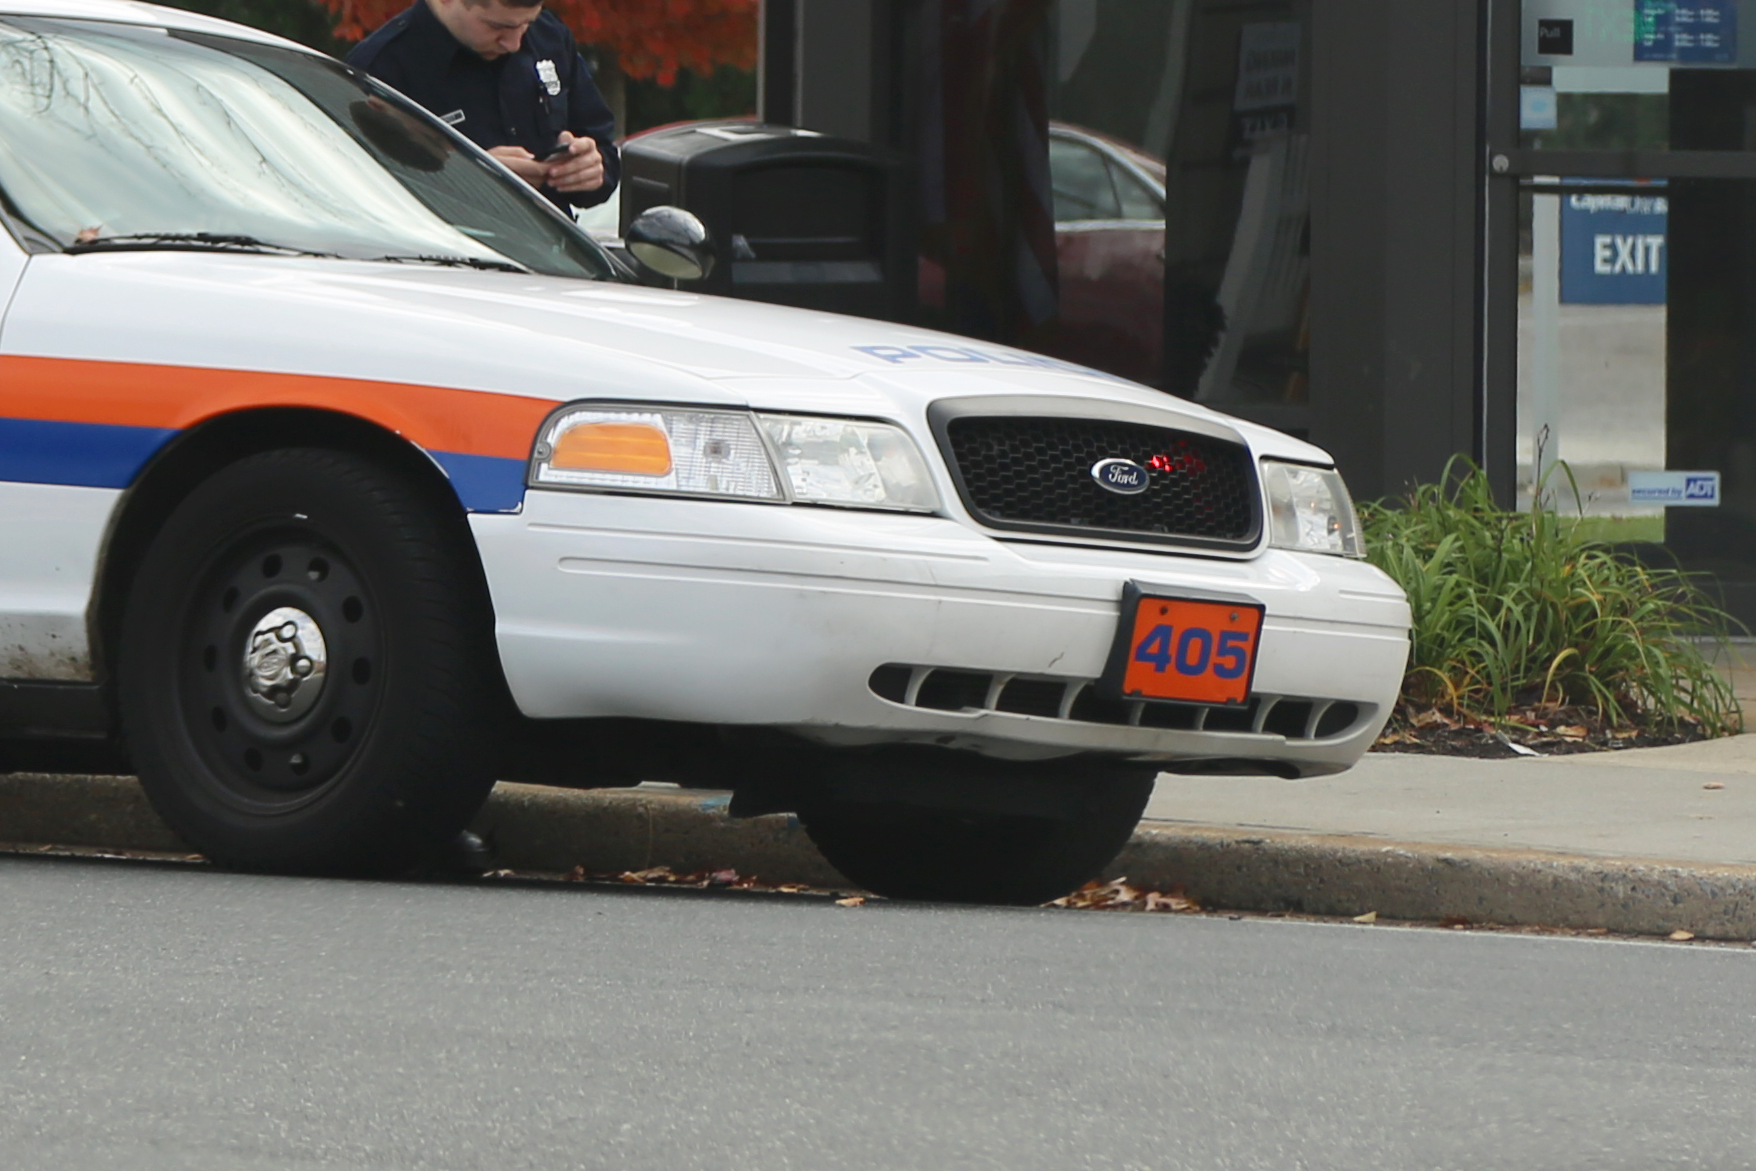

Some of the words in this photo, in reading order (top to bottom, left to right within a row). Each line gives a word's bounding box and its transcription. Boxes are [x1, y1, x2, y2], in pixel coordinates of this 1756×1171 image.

[1594, 233, 1664, 275] EXIT
[1108, 464, 1139, 486] Ford
[1686, 480, 1715, 496] ADT
[1134, 623, 1250, 680] 405
